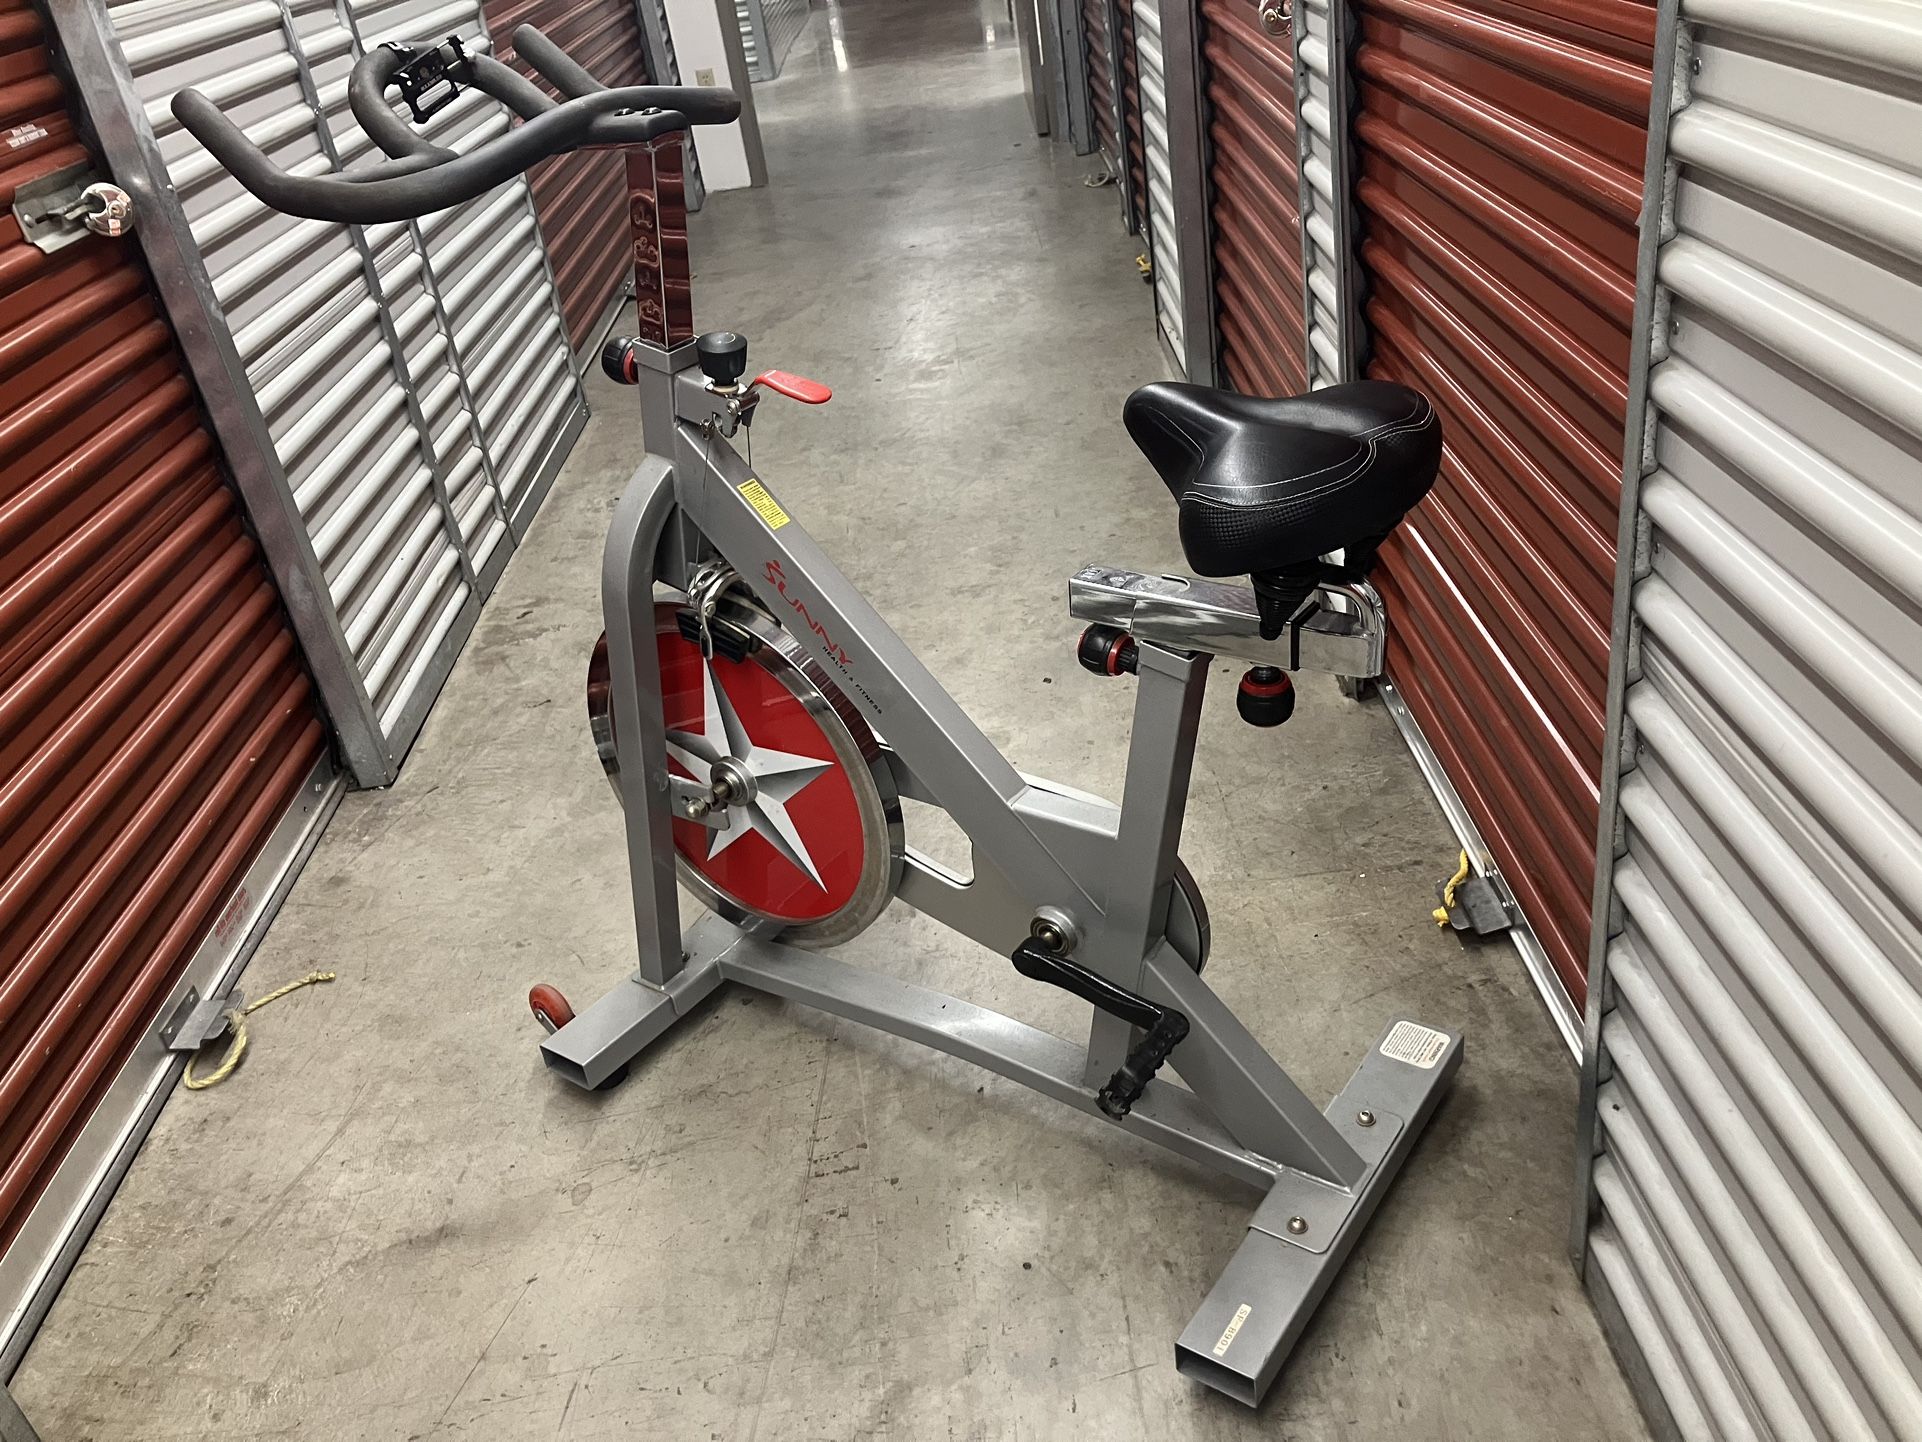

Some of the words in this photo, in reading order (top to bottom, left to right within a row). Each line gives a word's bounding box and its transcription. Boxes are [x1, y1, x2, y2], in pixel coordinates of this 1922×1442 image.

[763, 560, 853, 664] SUNNY
[822, 645, 848, 675] HEALTH
[855, 684, 882, 715] FITNESS
